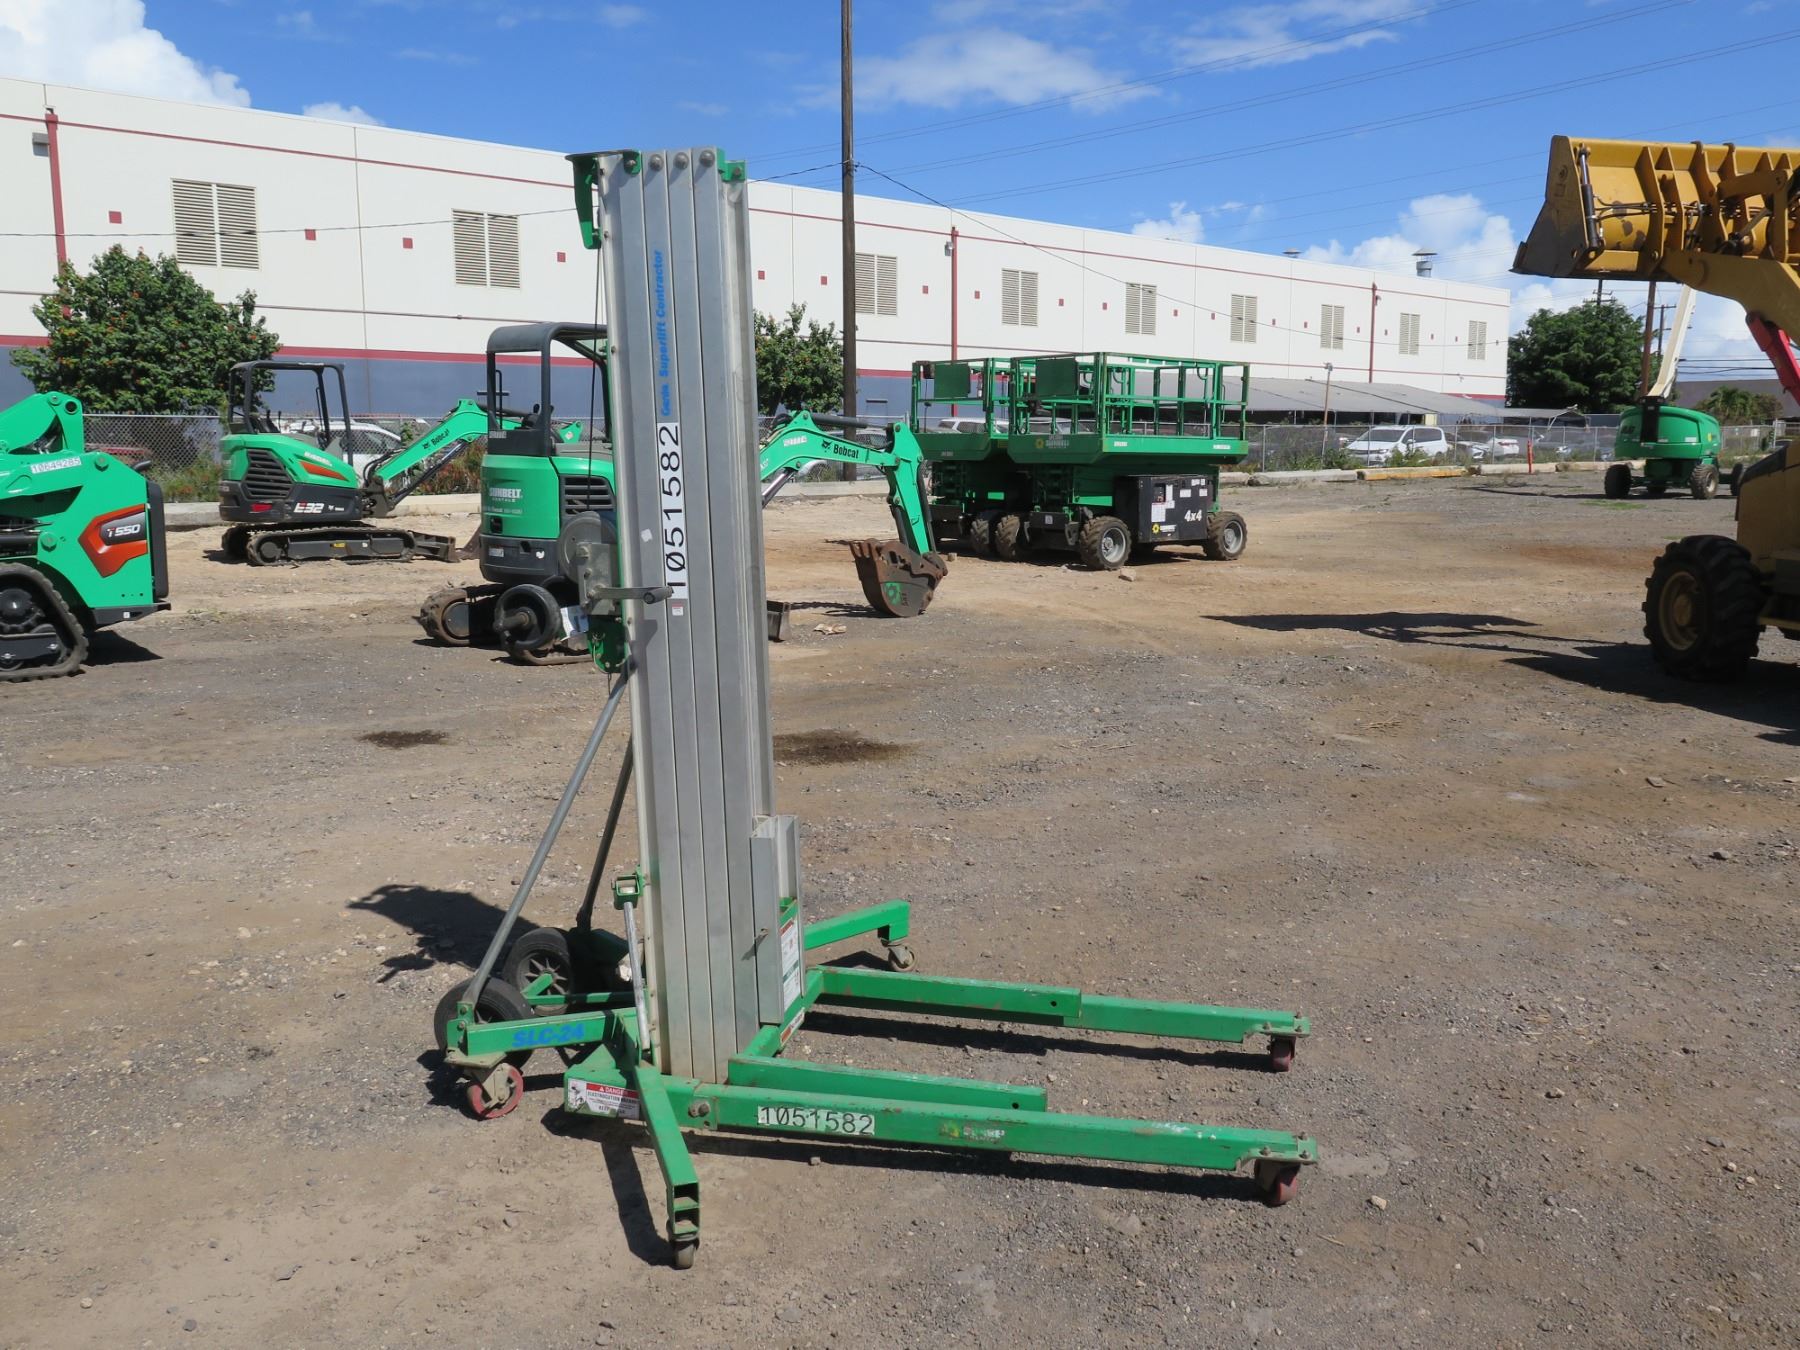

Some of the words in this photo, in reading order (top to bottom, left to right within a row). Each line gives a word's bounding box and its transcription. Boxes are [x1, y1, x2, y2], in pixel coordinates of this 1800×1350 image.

[653, 250, 666, 318] Contractor
[656, 321, 670, 377] Superlift
[833, 444, 859, 459] Bobcat
[293, 501, 325, 514] E32
[659, 425, 686, 594] 1051582
[1184, 509, 1203, 522] 4x4
[107, 523, 141, 538] T550
[512, 1023, 585, 1048] SLC-24
[760, 1106, 873, 1136] 1051582
